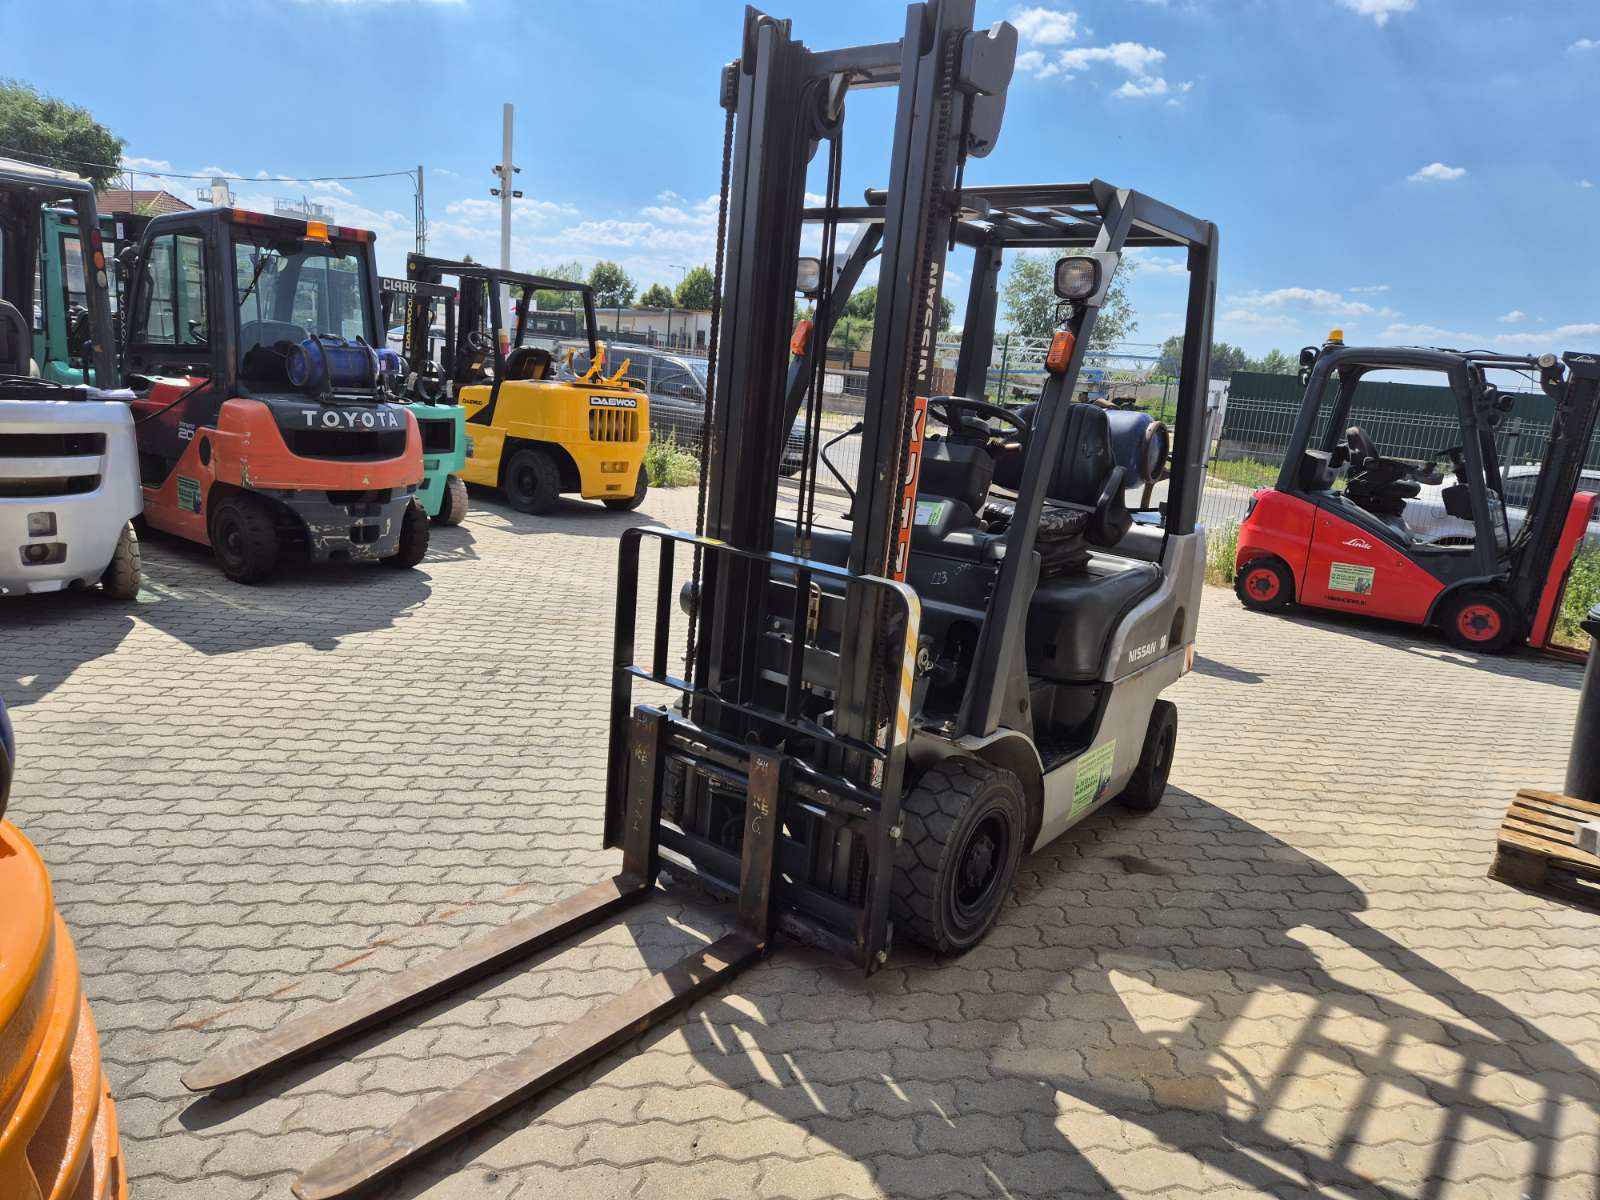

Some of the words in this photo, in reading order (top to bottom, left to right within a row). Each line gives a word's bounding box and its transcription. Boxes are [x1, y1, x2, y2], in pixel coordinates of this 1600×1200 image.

[383, 279, 417, 294] CLARK
[918, 262, 939, 381] NISSAN
[591, 397, 637, 408] DAEWOO
[301, 410, 399, 428] TOYOTA
[1342, 538, 1373, 550] Linde
[1128, 641, 1157, 664] NISSAN
